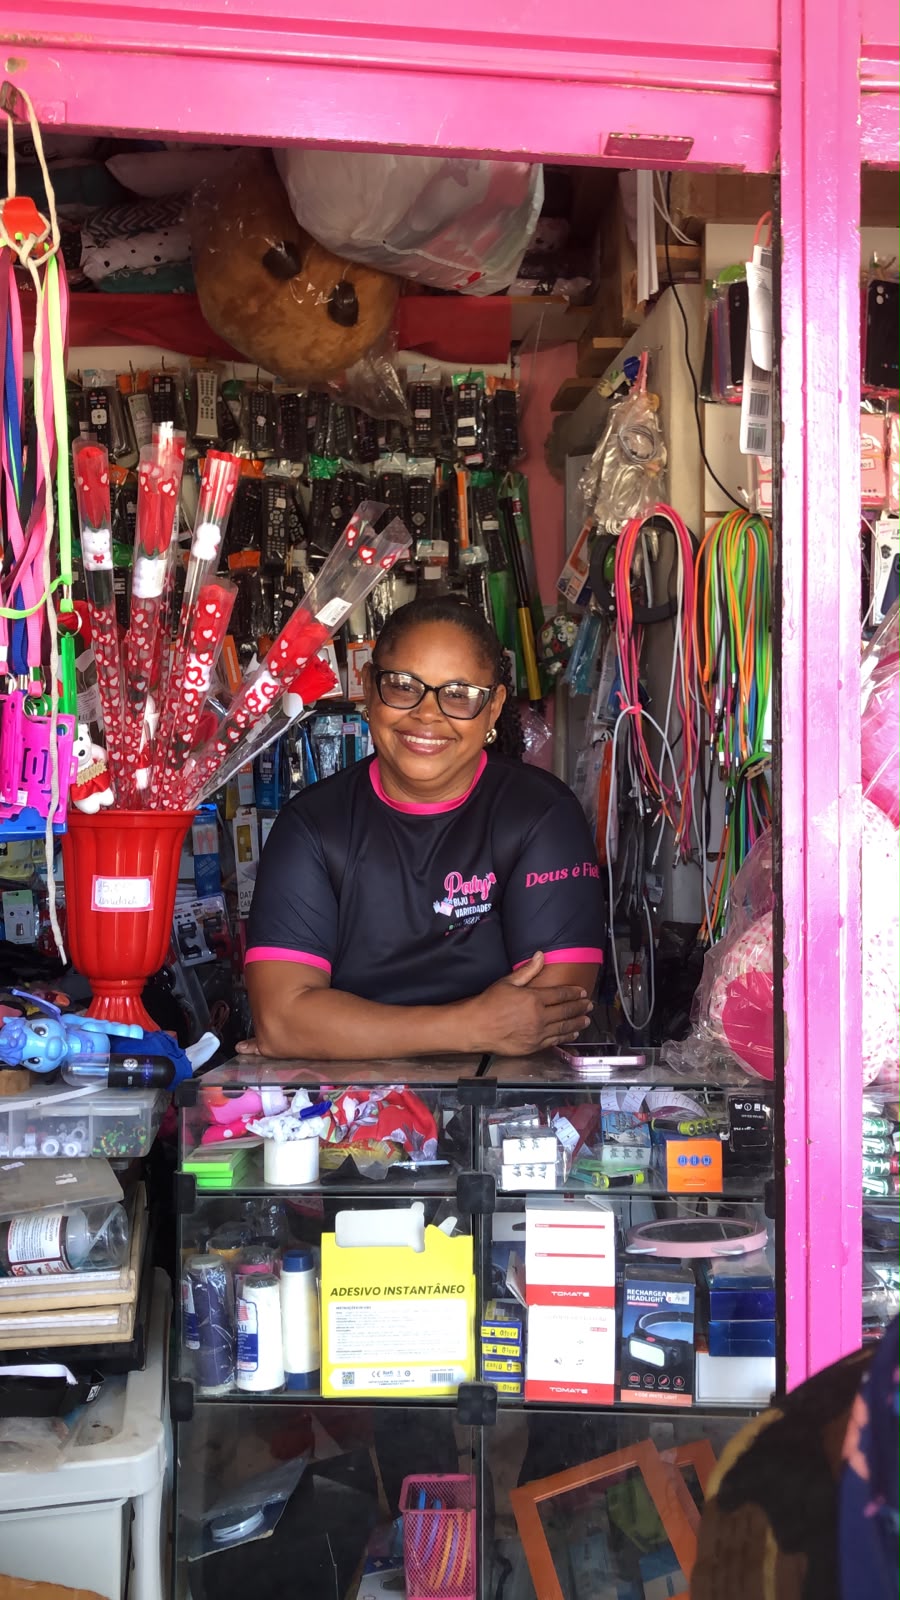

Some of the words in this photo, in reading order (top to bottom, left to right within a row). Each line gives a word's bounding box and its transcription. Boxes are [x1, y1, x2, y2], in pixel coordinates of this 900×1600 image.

[525, 868, 569, 888] Deus
[444, 871, 492, 901] Paty
[453, 896, 469, 907] BIJU
[455, 903, 492, 918] VARIEDADES
[330, 1287, 381, 1297] ADESIVO
[383, 1283, 465, 1296] INSTANTÂNEO
[626, 1295, 664, 1303] HEADLIGHT
[549, 1386, 588, 1394] TOMATE
